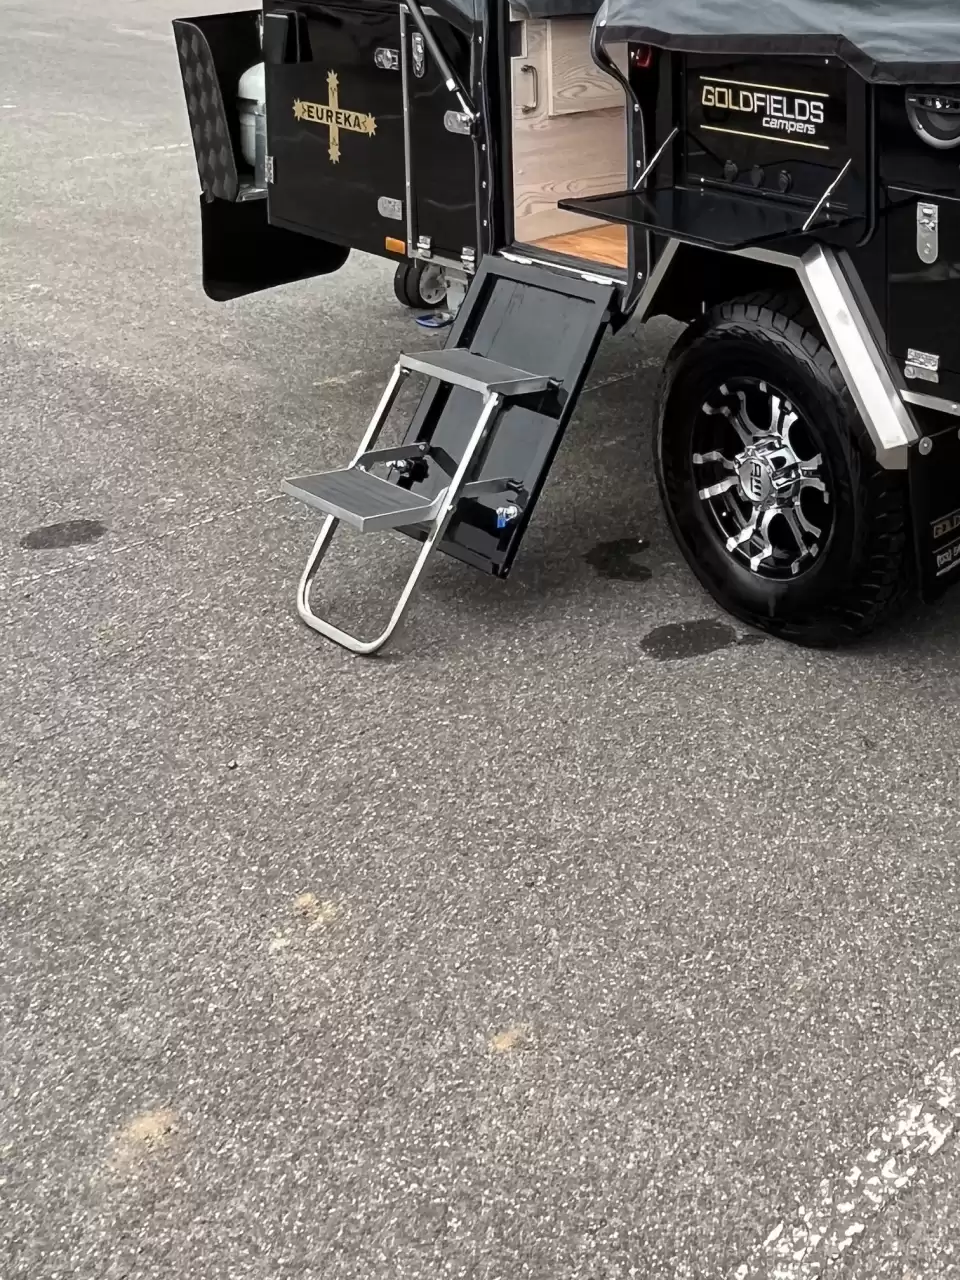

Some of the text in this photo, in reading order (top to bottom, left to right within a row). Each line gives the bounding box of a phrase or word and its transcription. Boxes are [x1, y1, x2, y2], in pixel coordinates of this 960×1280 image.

[702, 85, 825, 124] GOLDFIELDS
[306, 105, 362, 130] EUREKA
[762, 116, 816, 135] campers
